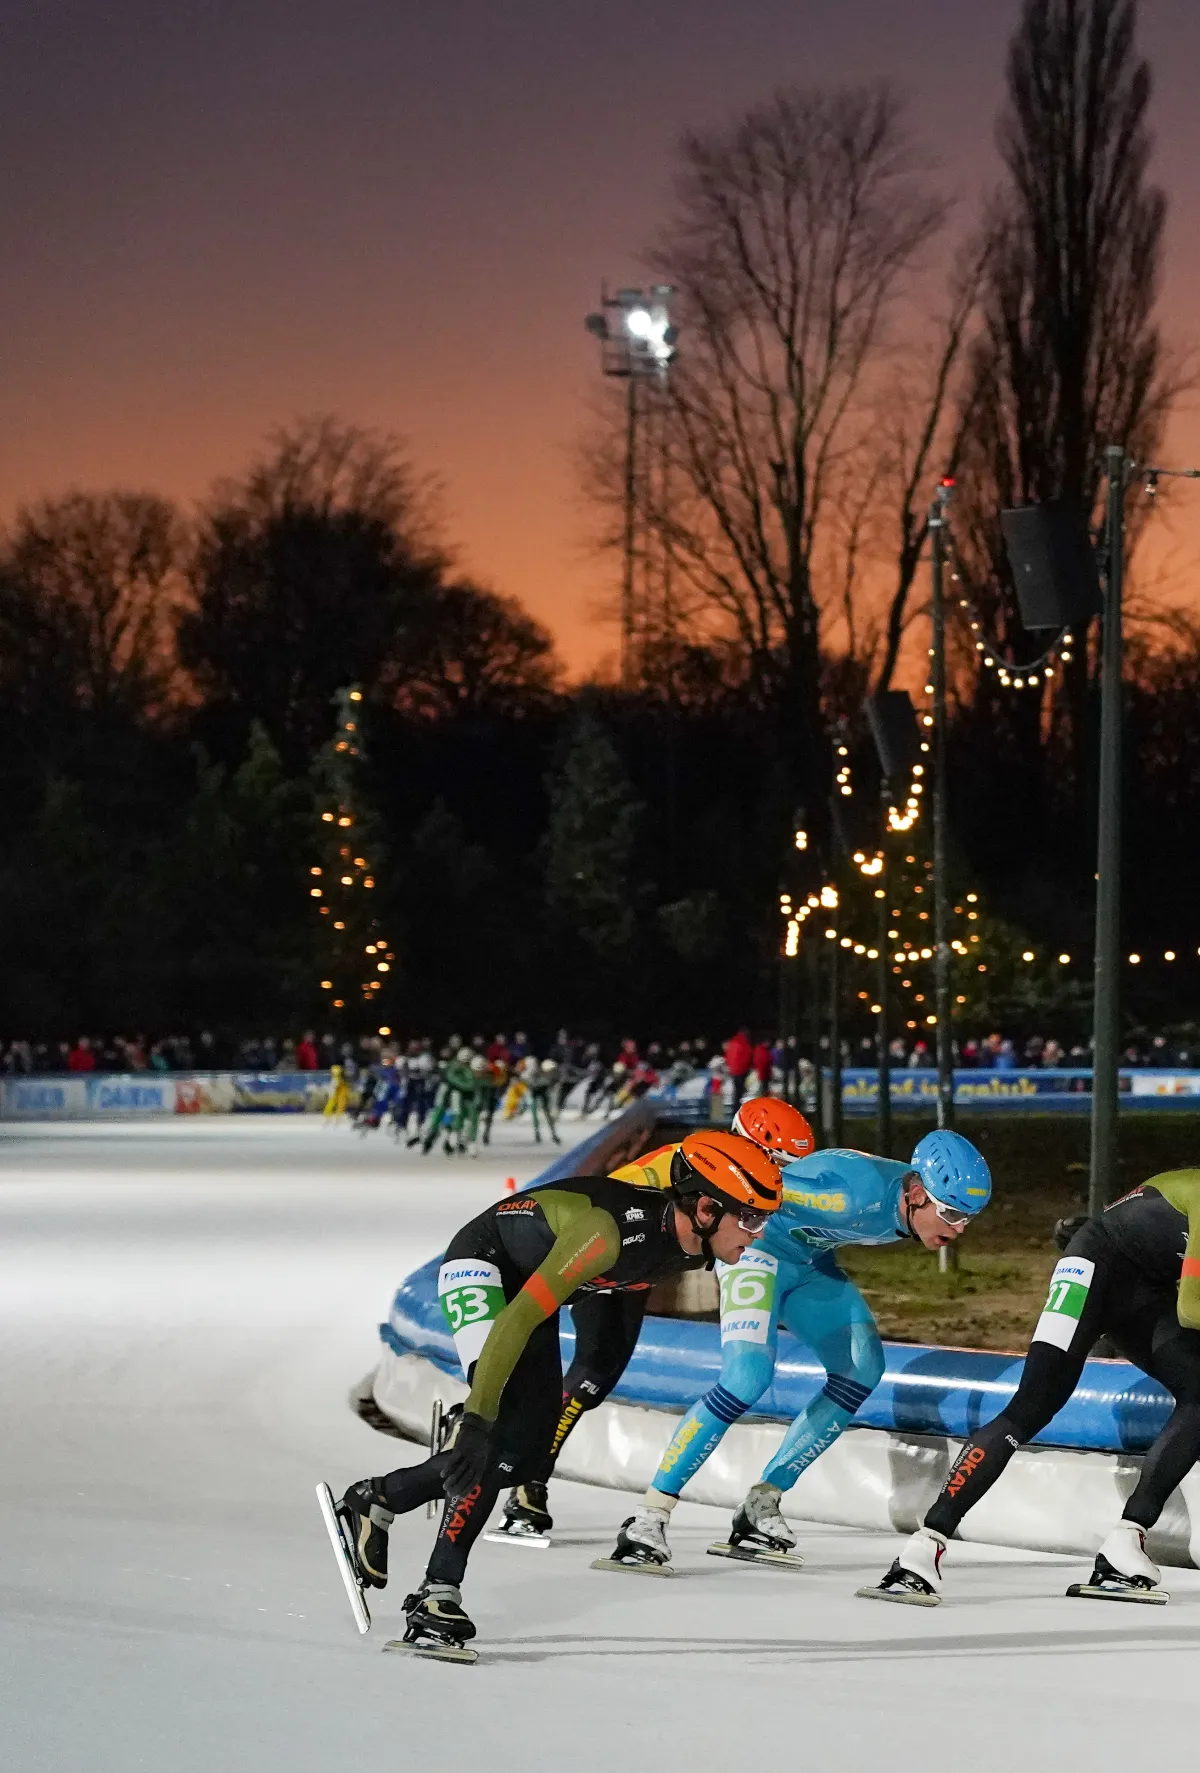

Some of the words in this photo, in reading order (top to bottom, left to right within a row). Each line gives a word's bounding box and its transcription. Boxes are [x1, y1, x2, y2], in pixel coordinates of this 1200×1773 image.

[497, 1199, 538, 1211] OKAY
[450, 1269, 491, 1281] DAIKIN
[1056, 1267, 1084, 1276] DAIKIN
[446, 1287, 490, 1329] 53
[580, 1379, 600, 1396] FIL
[786, 1419, 841, 1476] A-WARE
[953, 1443, 974, 1470] FASHION
[947, 1447, 986, 1498] OKAY
[438, 1513, 452, 1539] JEANS
[445, 1483, 482, 1544] OKAY
